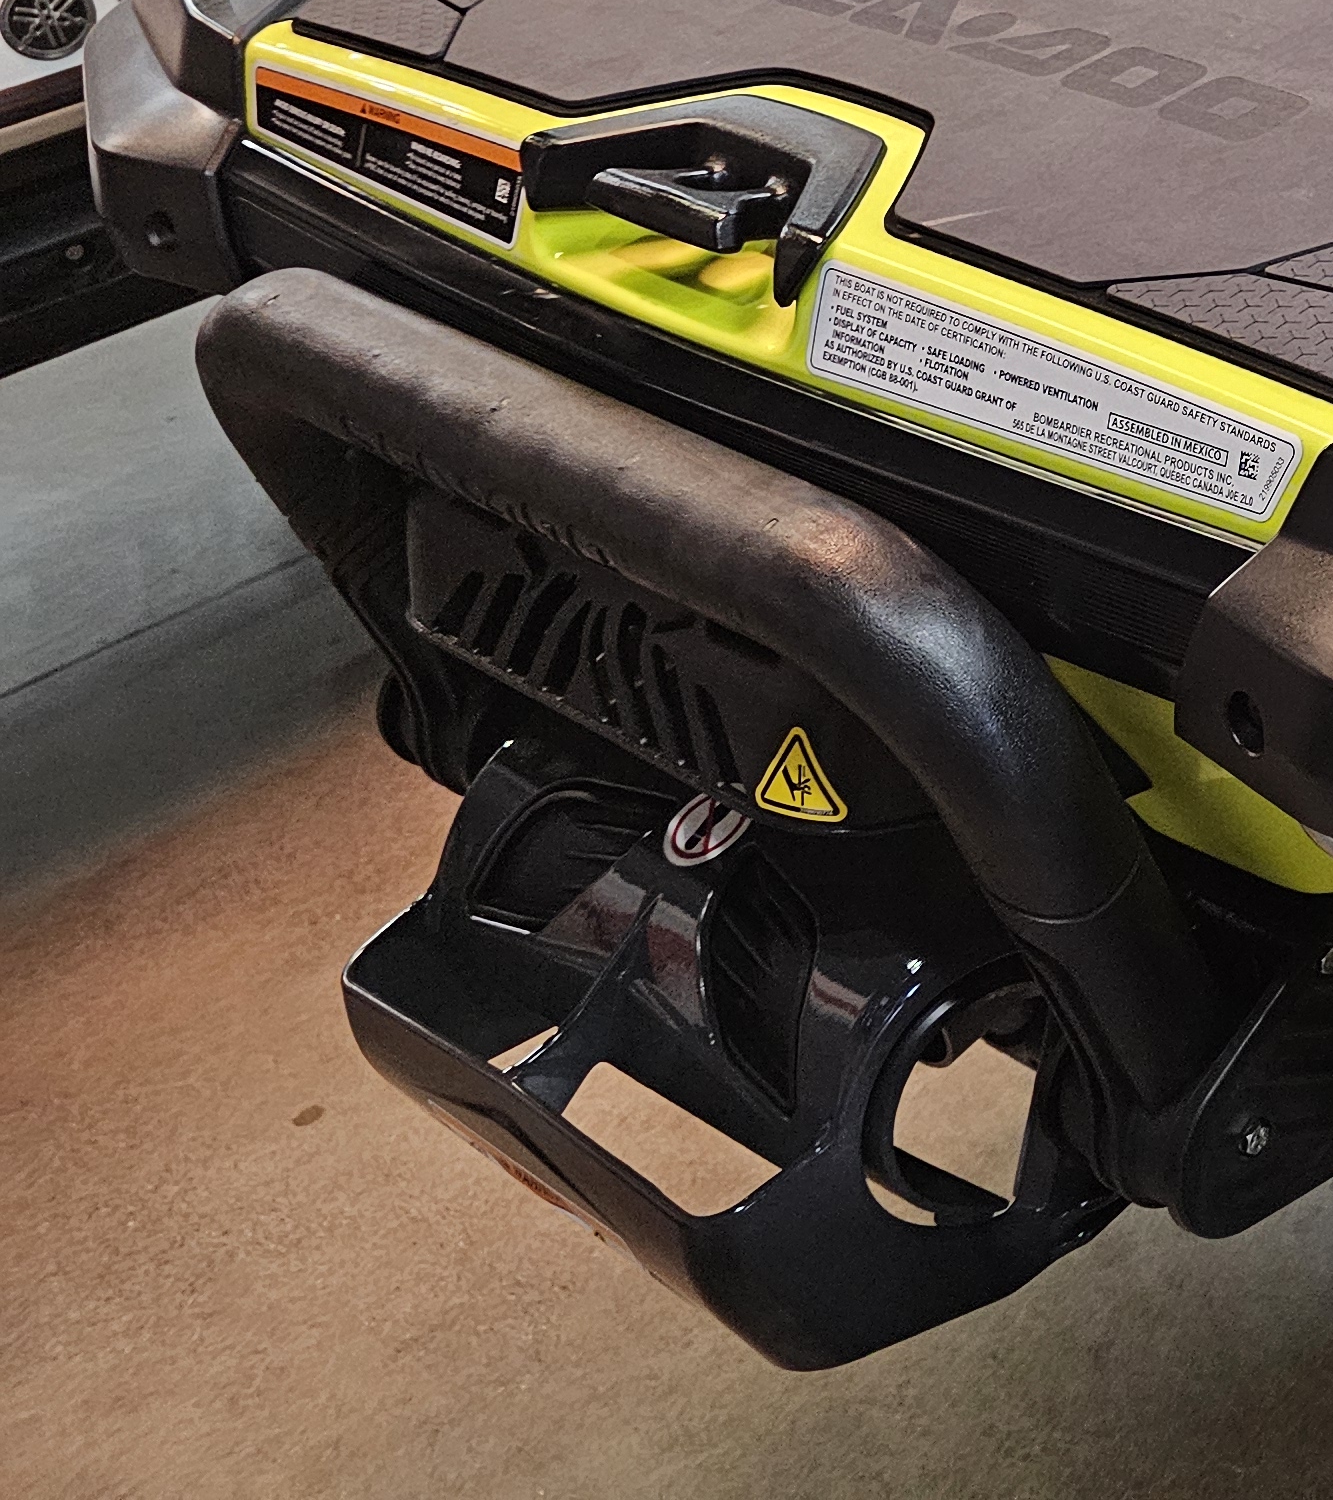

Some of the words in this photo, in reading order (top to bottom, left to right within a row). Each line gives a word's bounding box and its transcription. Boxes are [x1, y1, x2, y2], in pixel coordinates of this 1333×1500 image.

[833, 289, 841, 299] IN
[842, 292, 872, 313] EFFECT
[874, 303, 885, 314] ON
[888, 307, 903, 320] THE
[905, 314, 926, 329] DATE
[928, 322, 939, 333] OF
[941, 327, 1006, 360] CERTIFICATION:
[834, 318, 865, 335] DISPLAY
[867, 328, 878, 339] OF
[879, 332, 917, 352] CAPACITY
[836, 305, 854, 318] FUEL
[857, 312, 888, 329] SYSTEM
[833, 330, 885, 354] INFORMATION
[927, 346, 947, 361] SAFE
[949, 355, 985, 373] LOADING
[823, 352, 867, 374] EXEMPTION
[868, 367, 887, 380] (CGB
[824, 339, 835, 350] AS
[837, 343, 885, 366] AUTHORIZED
[887, 359, 898, 370] BY
[900, 363, 914, 378] U.S.
[916, 369, 943, 387] COAST
[945, 380, 973, 397] GUARD
[975, 391, 1003, 408] GRANT
[1005, 401, 1017, 412] OF
[836, 275, 852, 289] THIS
[854, 280, 876, 296] BOAT
[877, 288, 884, 299] IS
[886, 291, 903, 306] NOT
[905, 298, 947, 323] REQUIRED
[949, 315, 960, 327] TO
[961, 319, 996, 341] COMPLY
[998, 333, 1019, 350] WITH
[1022, 341, 1038, 357] THE
[1040, 351, 1092, 378] FOLLOWING
[1095, 372, 1111, 385] U.S.
[1114, 379, 1145, 398] COAST
[1147, 392, 1180, 412] GUARD
[1182, 406, 1218, 427] SAFETY
[1220, 423, 1277, 452] STANDARDS
[924, 358, 969, 381] FLOTATION
[999, 370, 1040, 391] POWERED
[1043, 384, 1099, 411] VENTILATION
[1013, 419, 1024, 430] 565
[1026, 423, 1035, 434] DE
[1036, 428, 1045, 438] LA
[1047, 430, 1087, 450] MONTAGNE
[1089, 443, 1117, 461] STREET
[1118, 452, 1159, 476] VALCOURT,
[1192, 478, 1223, 497] CANADA
[1033, 412, 1092, 439] BOMBARDIER
[1094, 434, 1161, 463] RECREATIONAL
[1164, 454, 1214, 479] PRODUCTS
[1112, 418, 1169, 445] ASSEMBLED
[1171, 437, 1181, 449] IN
[1183, 440, 1221, 461] MEXICO
